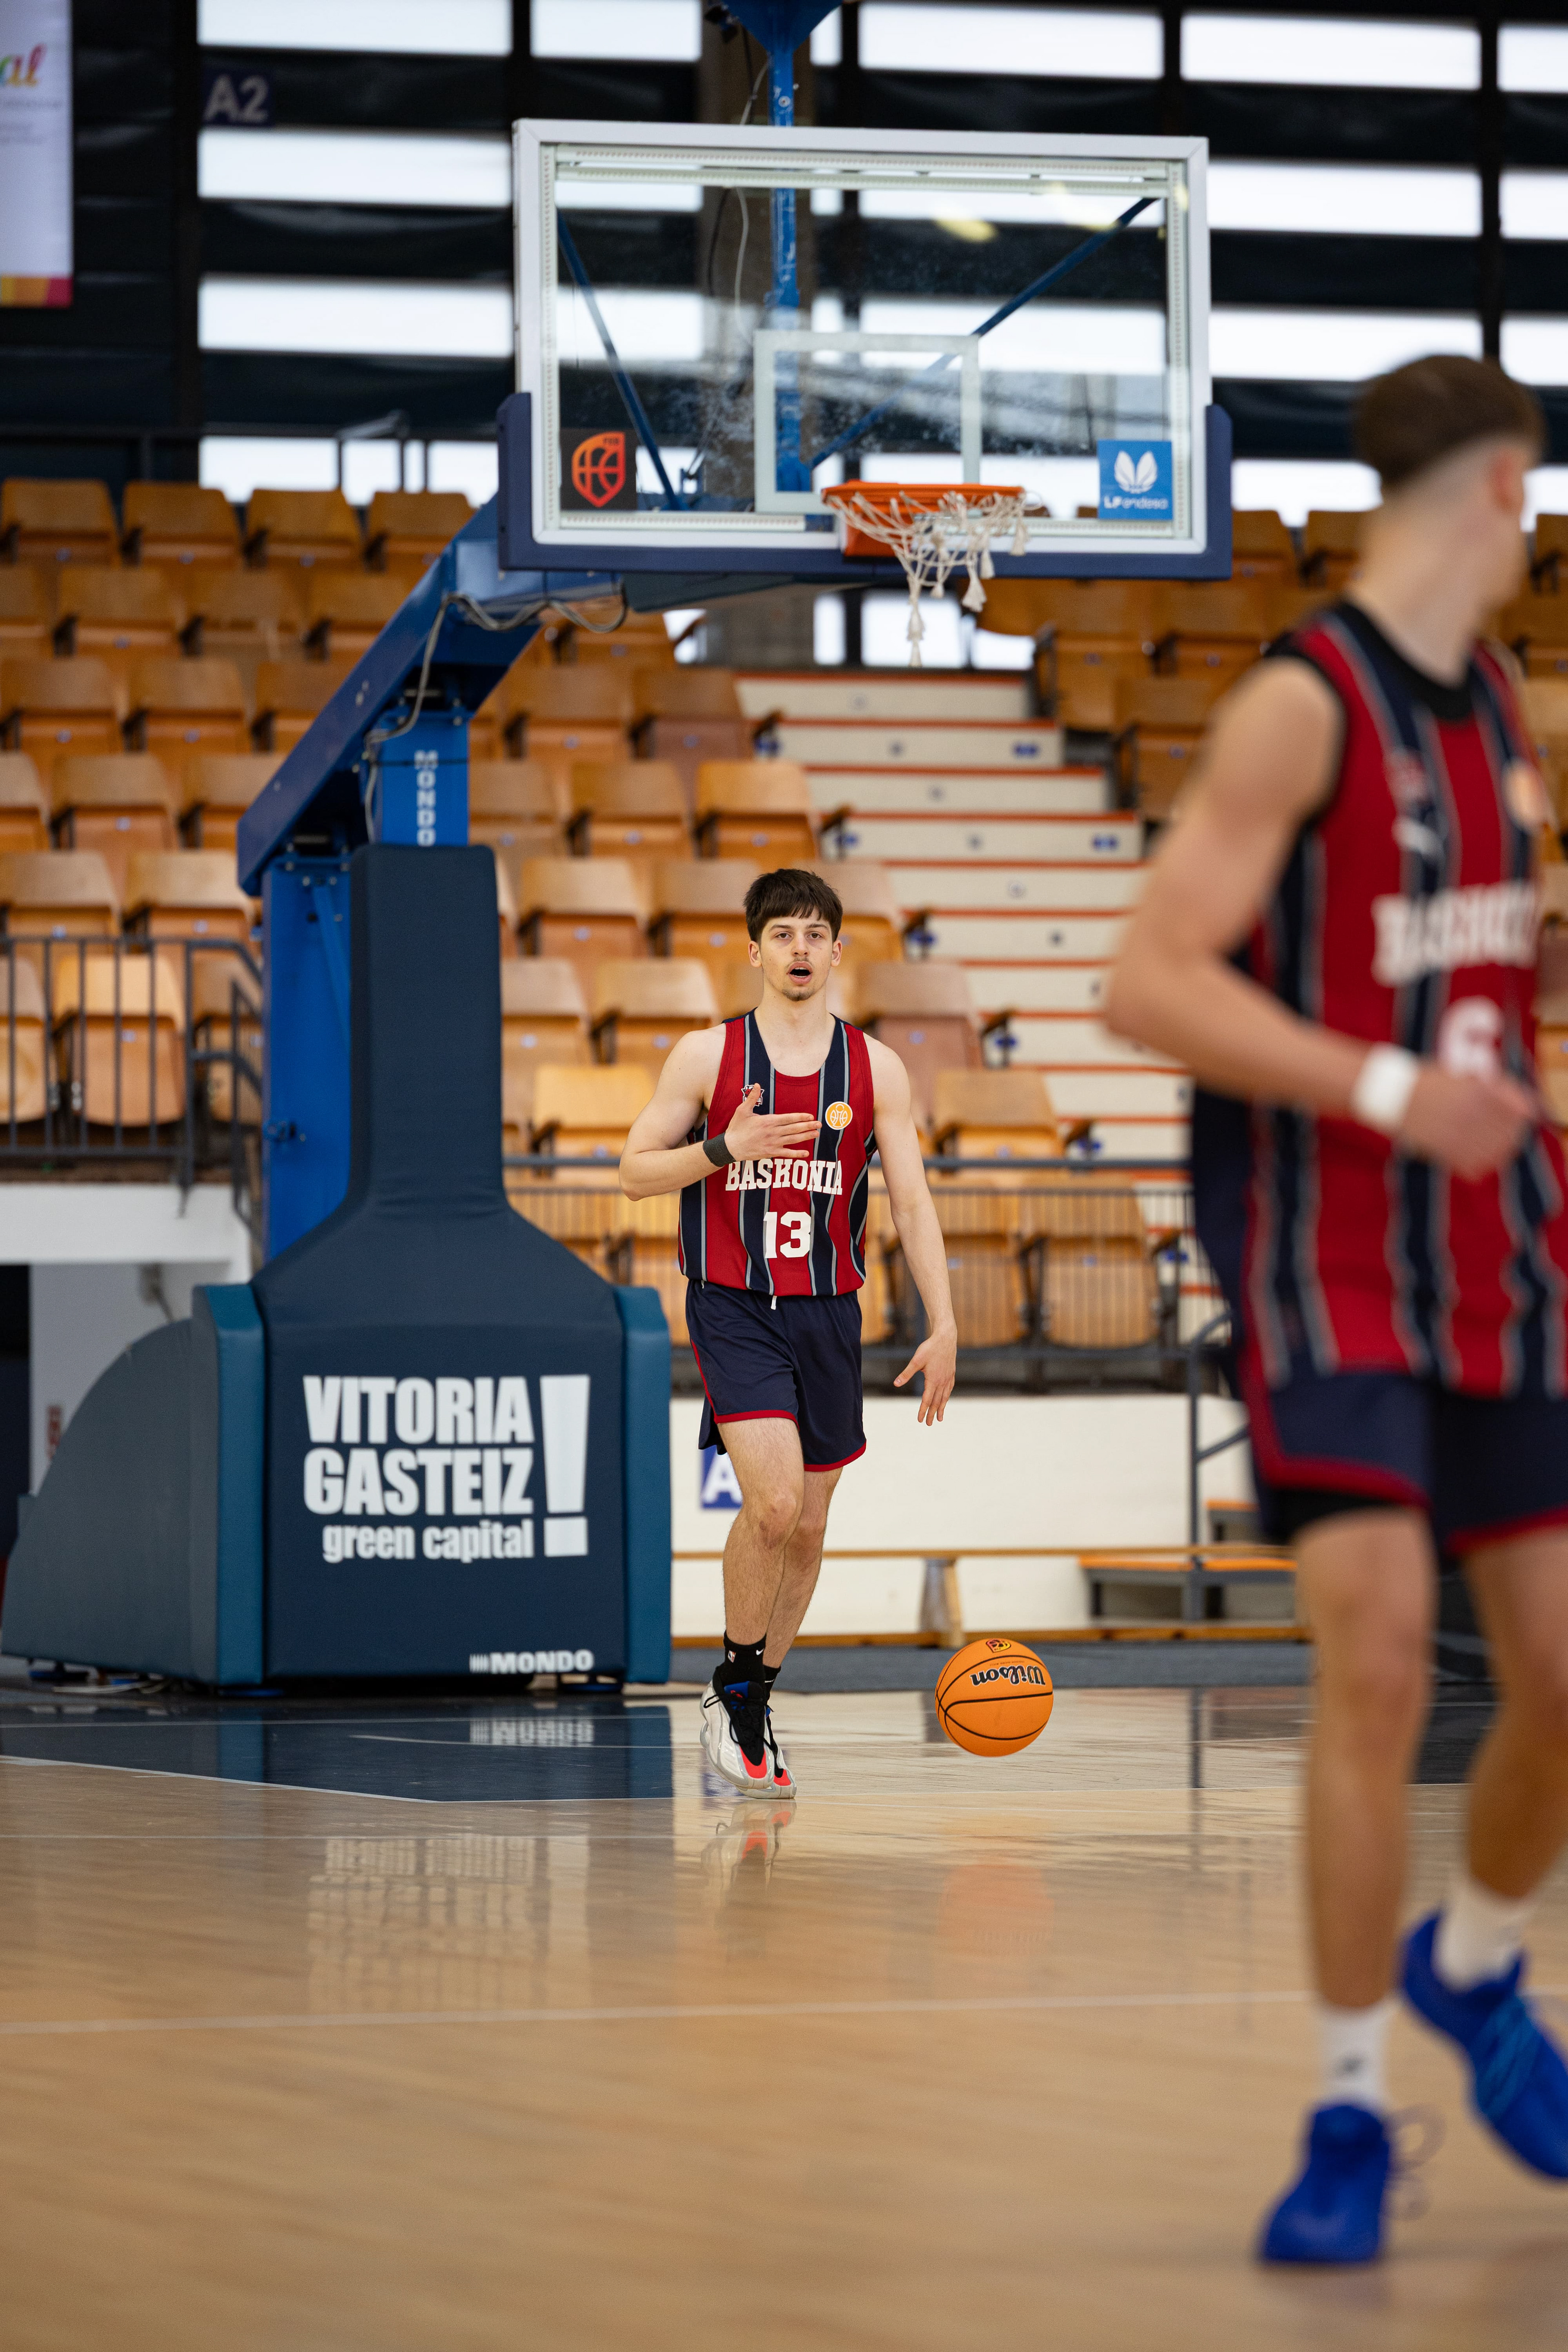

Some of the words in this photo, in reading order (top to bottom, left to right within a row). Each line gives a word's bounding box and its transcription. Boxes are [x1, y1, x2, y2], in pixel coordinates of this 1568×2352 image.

[205, 74, 270, 122] A2
[725, 1158, 842, 1195] BASKONIA
[763, 1212, 811, 1258] 13
[303, 1375, 535, 1443] VITORIA
[303, 1448, 534, 1515] GASTEIZ
[322, 1525, 416, 1563] green
[423, 1518, 534, 1563] capital
[490, 1650, 594, 1674] MONDO
[969, 1664, 1046, 1686] Wilson
